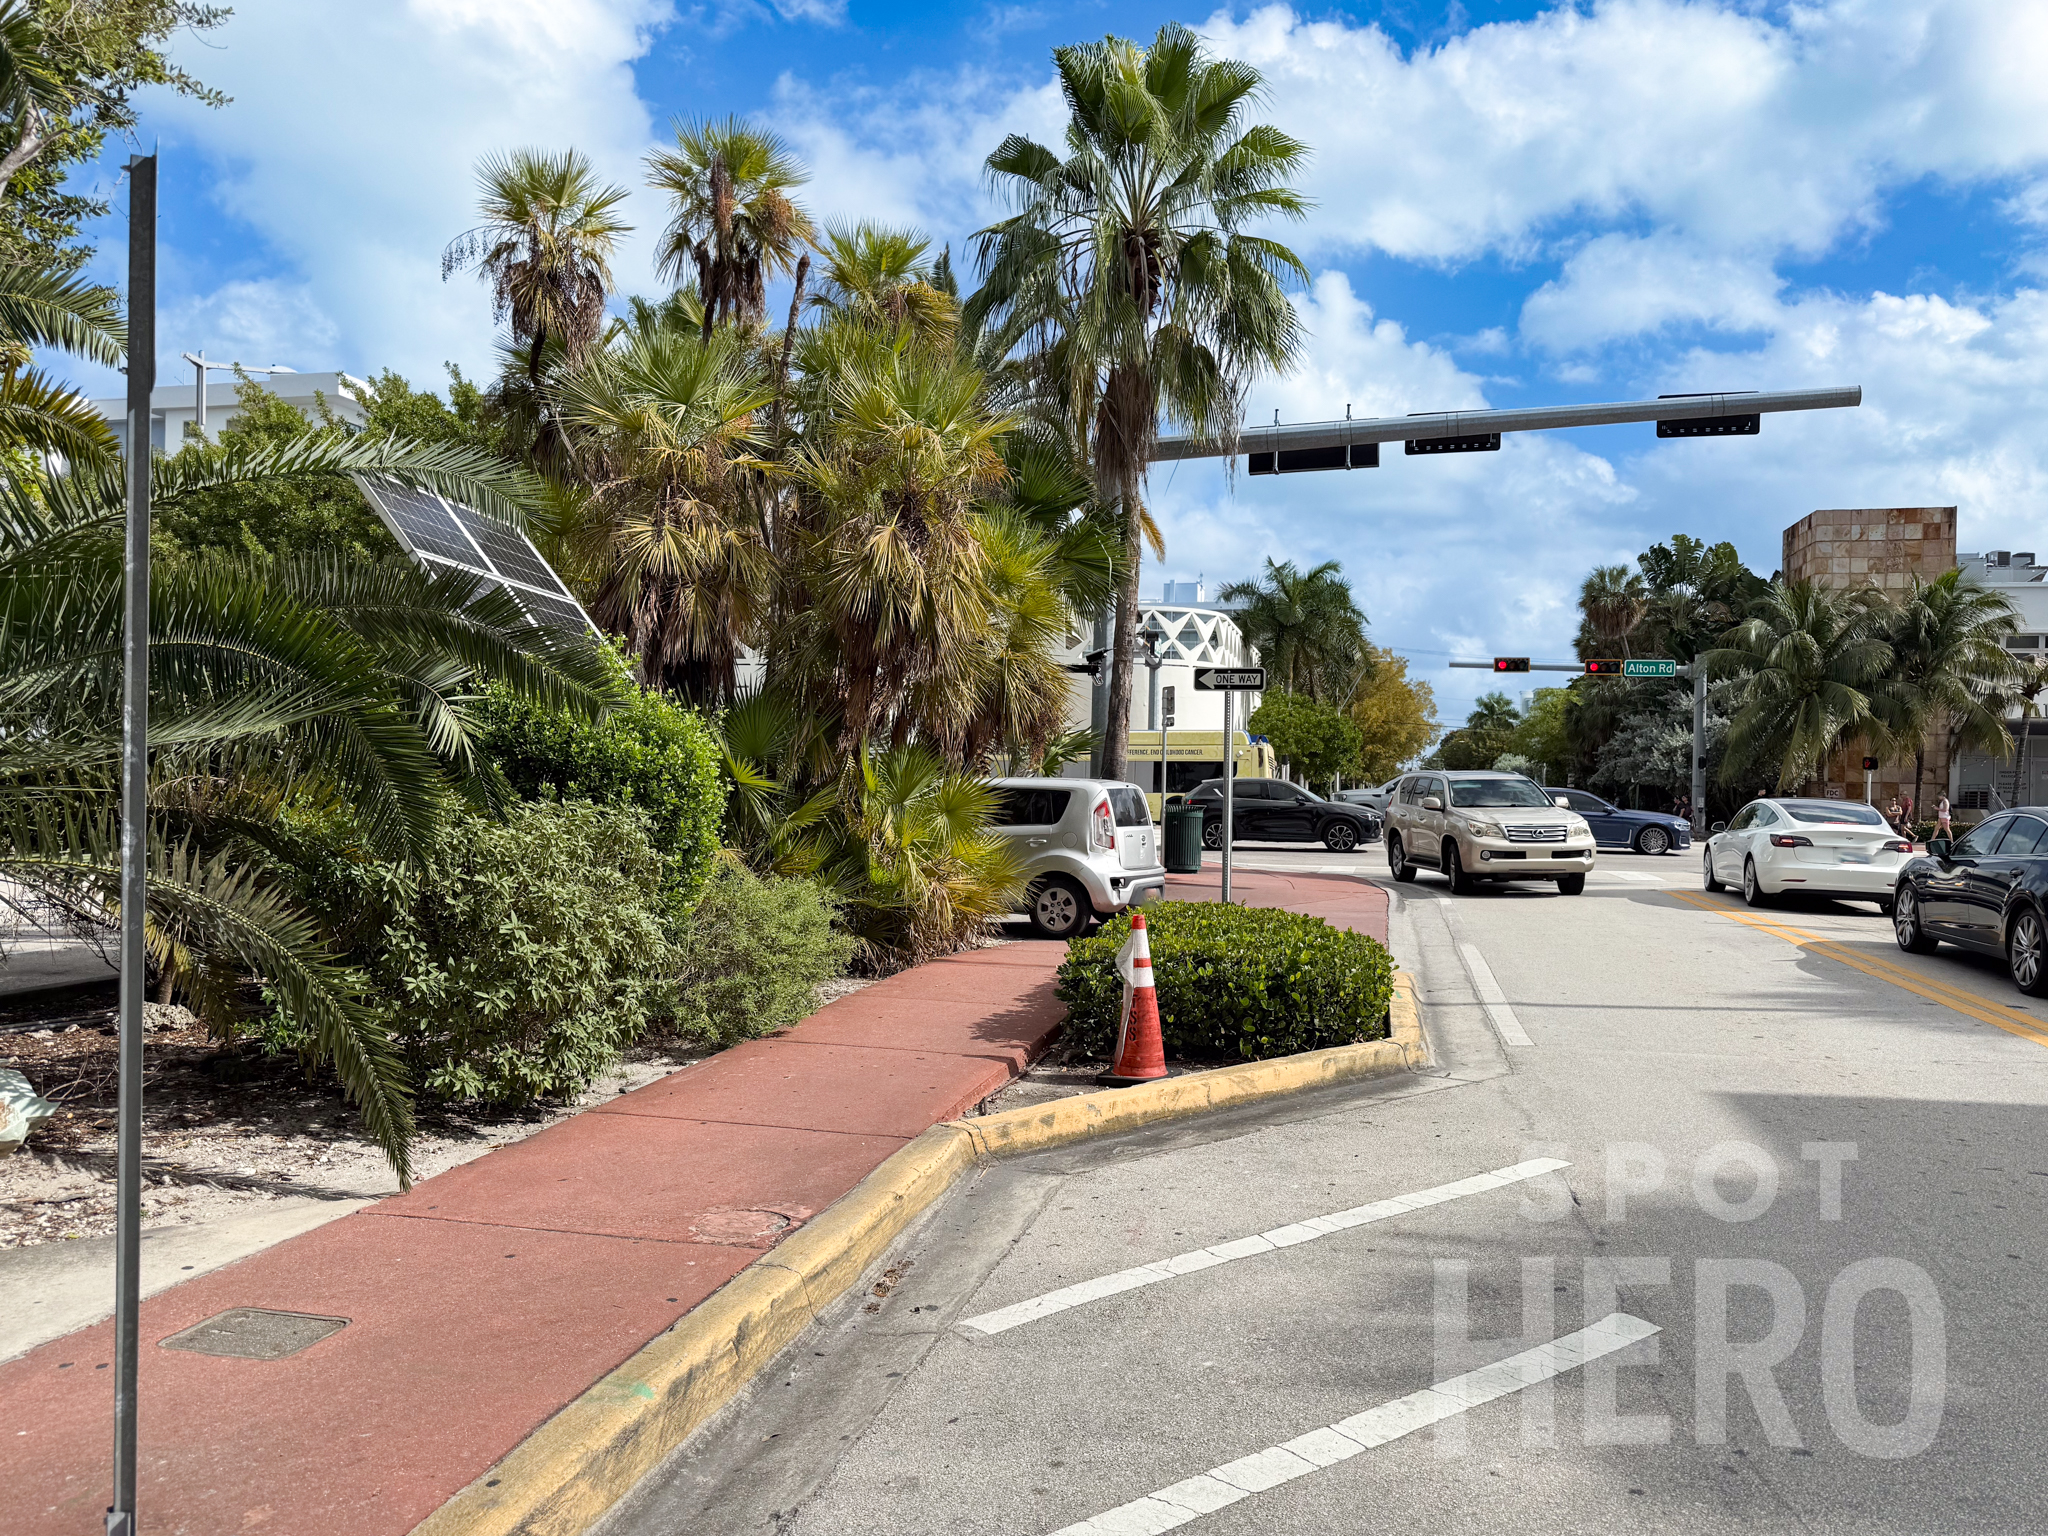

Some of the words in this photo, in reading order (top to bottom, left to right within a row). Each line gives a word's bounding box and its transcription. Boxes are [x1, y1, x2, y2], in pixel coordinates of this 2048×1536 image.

[1627, 663, 1656, 673] Alton
[1659, 663, 1673, 673] Rd
[1215, 674, 1235, 684] ONE
[1238, 674, 1259, 684] WAY
